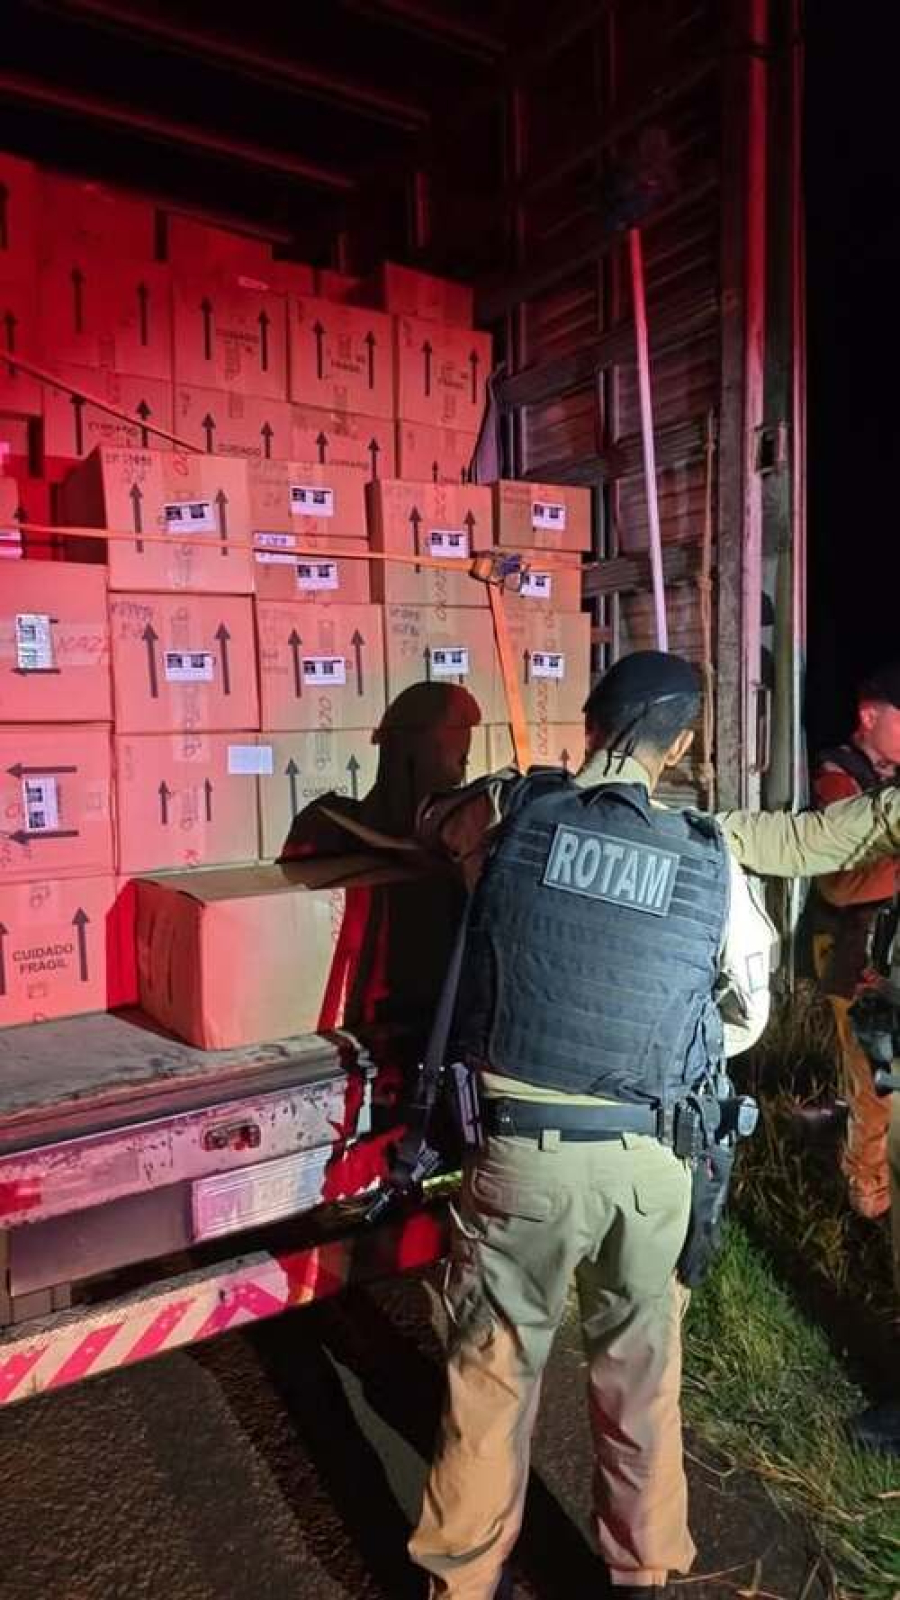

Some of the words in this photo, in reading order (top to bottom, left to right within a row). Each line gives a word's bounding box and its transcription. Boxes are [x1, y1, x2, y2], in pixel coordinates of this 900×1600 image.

[551, 832, 672, 908] ROTAM
[12, 943, 74, 962] CUIDADO
[19, 960, 68, 974] FRAGIL
